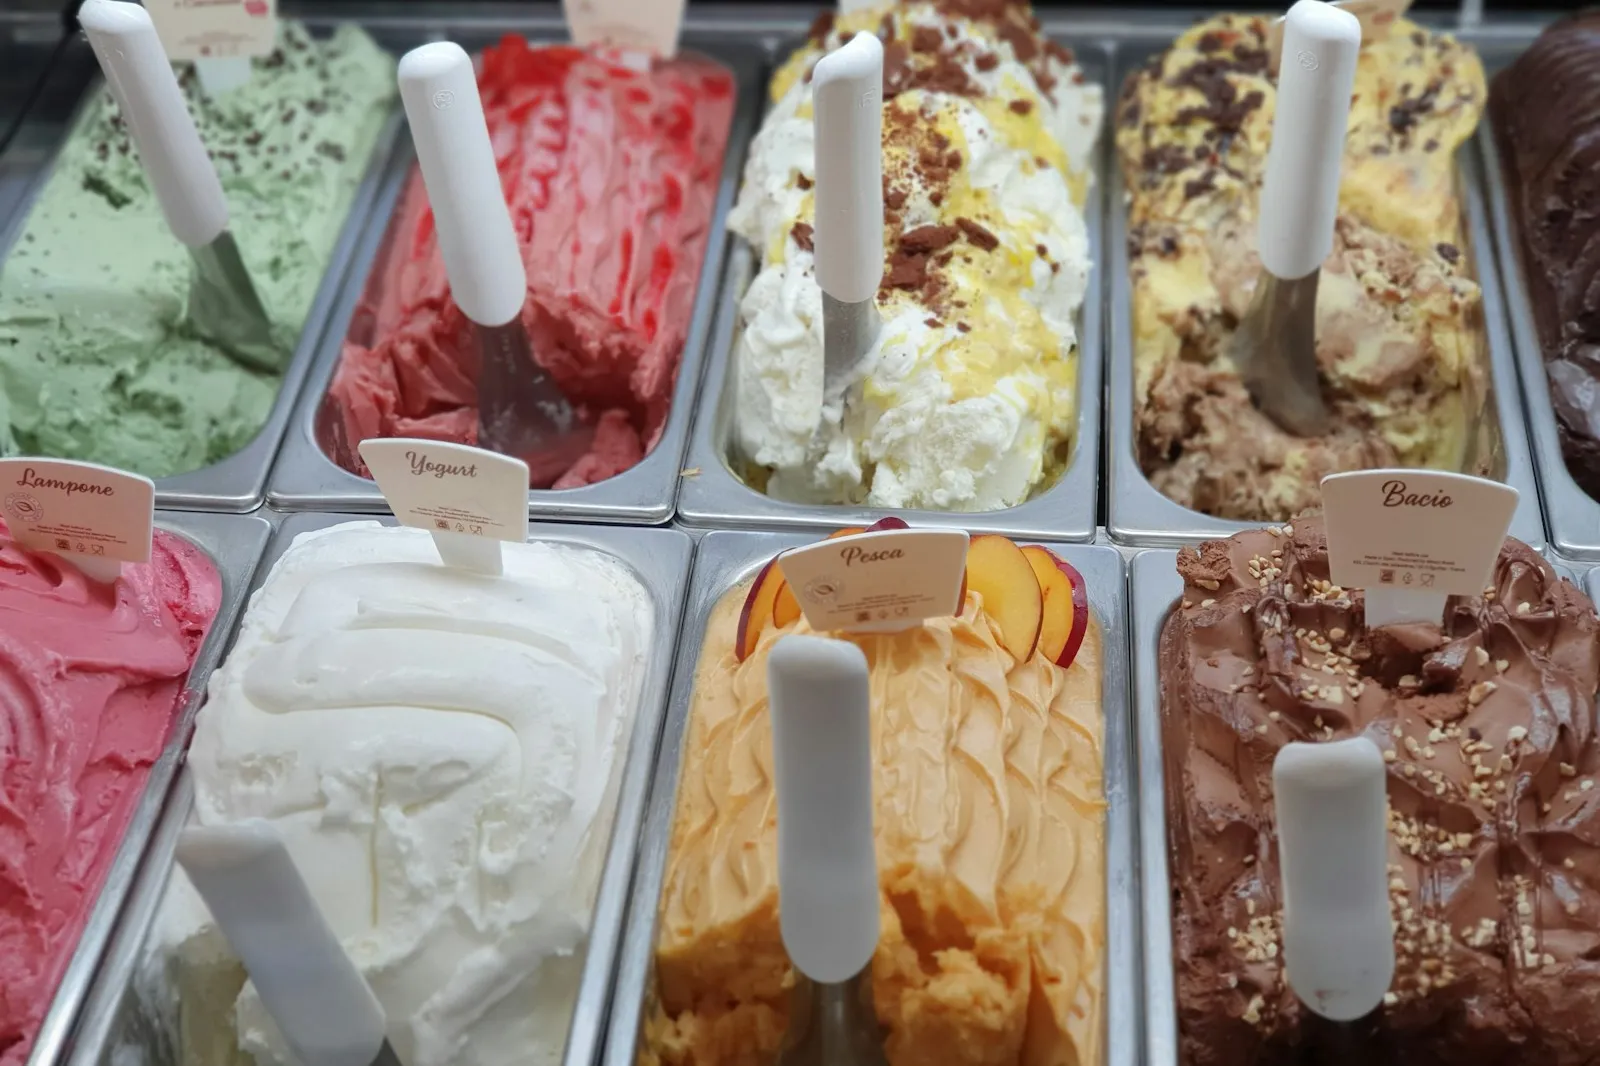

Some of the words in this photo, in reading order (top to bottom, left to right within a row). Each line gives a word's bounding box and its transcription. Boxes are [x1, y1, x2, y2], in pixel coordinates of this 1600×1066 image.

[405, 450, 478, 479] Yogurt
[16, 467, 115, 496] Lampone
[1381, 480, 1454, 508] Bacio
[840, 546, 905, 567] Pesca
